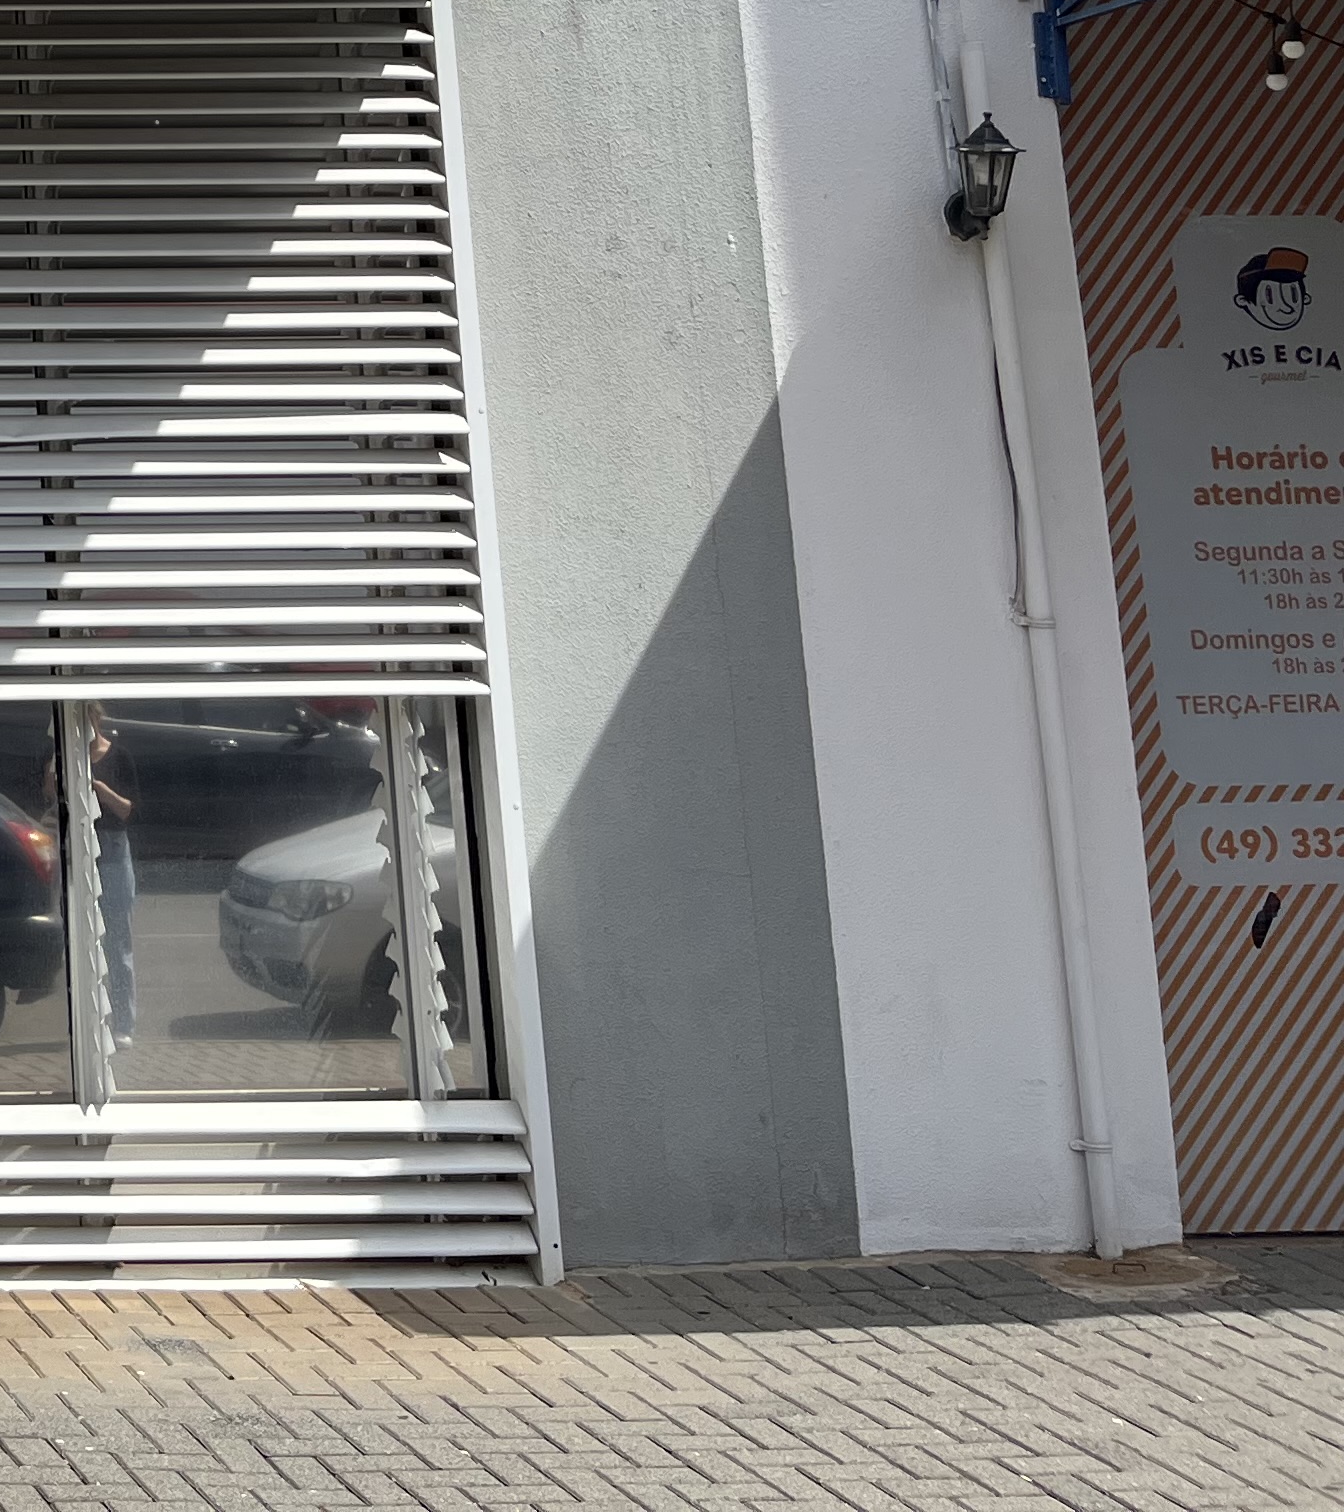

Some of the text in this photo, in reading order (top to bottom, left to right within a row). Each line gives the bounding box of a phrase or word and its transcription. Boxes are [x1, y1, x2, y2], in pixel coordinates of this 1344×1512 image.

[1221, 344, 1342, 372] XIS E CIA
[1211, 443, 1329, 471] Horário
[1193, 478, 1344, 506] atendime
[1194, 540, 1304, 567] Segunda
[1312, 544, 1326, 561] a
[1237, 567, 1304, 585] 11:30h
[1309, 567, 1332, 585] às
[1264, 592, 1300, 610] 18h
[1306, 592, 1328, 609] às
[1190, 628, 1315, 655] Domingos
[1322, 632, 1337, 649] e
[1272, 657, 1308, 675] 18h
[1313, 657, 1336, 675] às
[1176, 692, 1341, 719] TERÇA-FEIRA
[1200, 825, 1279, 864] (49)
